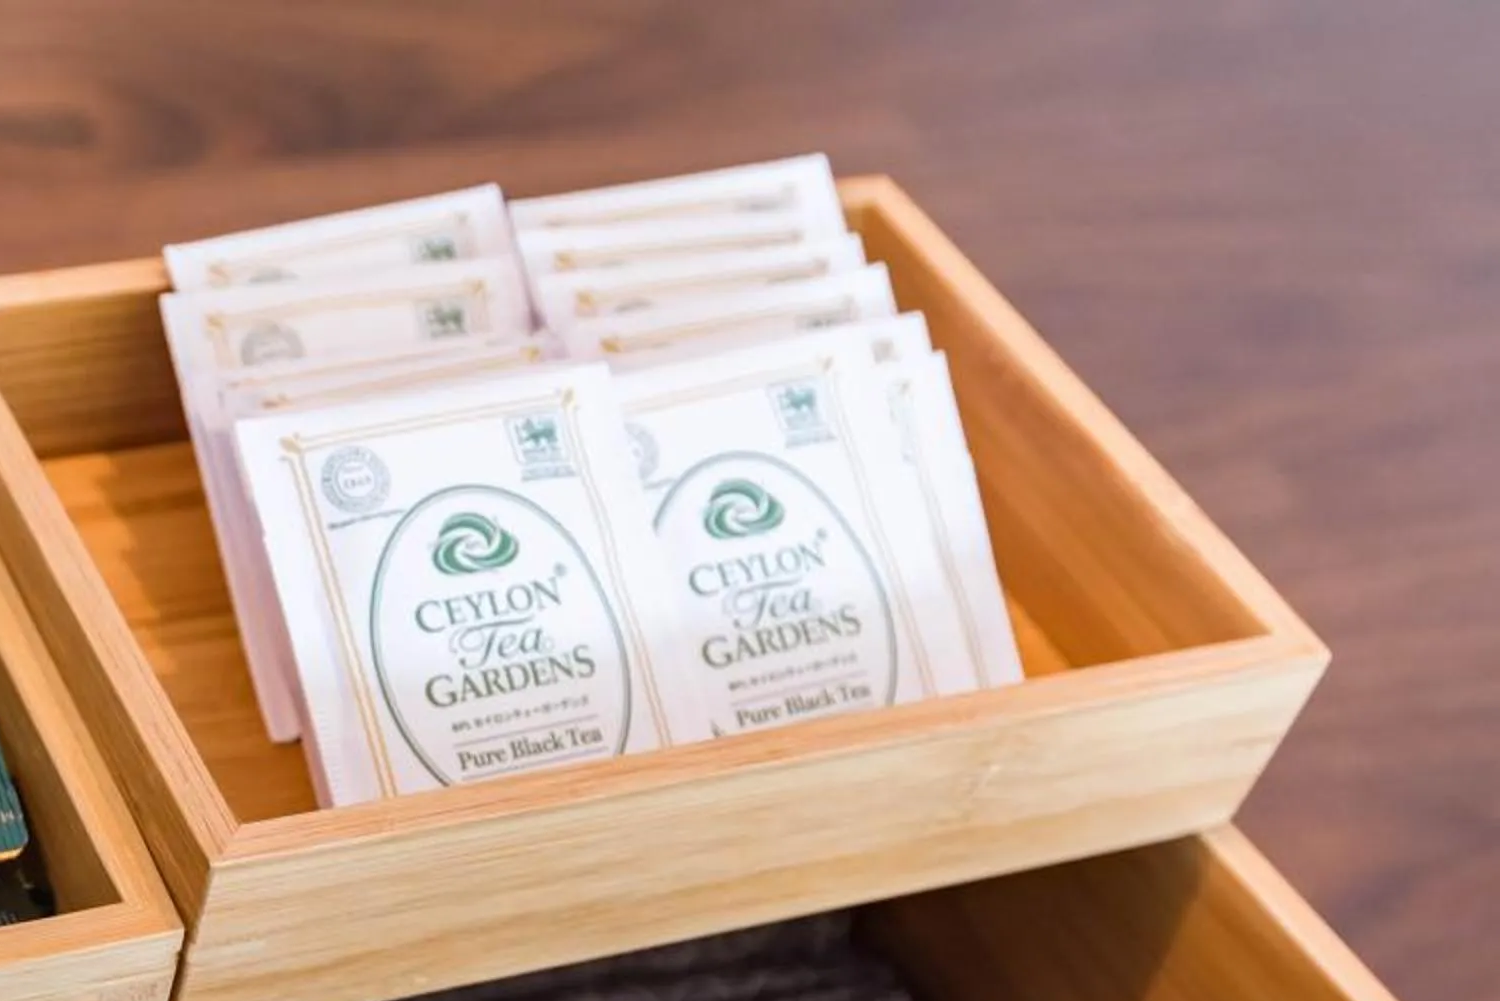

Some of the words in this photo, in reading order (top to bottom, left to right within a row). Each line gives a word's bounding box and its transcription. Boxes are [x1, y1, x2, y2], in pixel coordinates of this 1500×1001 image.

[688, 543, 826, 597] CEYLON
[414, 578, 563, 634] CEYLON
[723, 578, 814, 631] Tea
[450, 615, 546, 670] Tea
[701, 602, 862, 670] GARDENS
[424, 644, 596, 708] GARDENS
[736, 705, 782, 728] Pure
[785, 688, 836, 715] Black
[837, 682, 872, 702] Tea
[457, 746, 508, 771] Pure
[509, 731, 564, 758] Black
[565, 723, 604, 747] Tea
